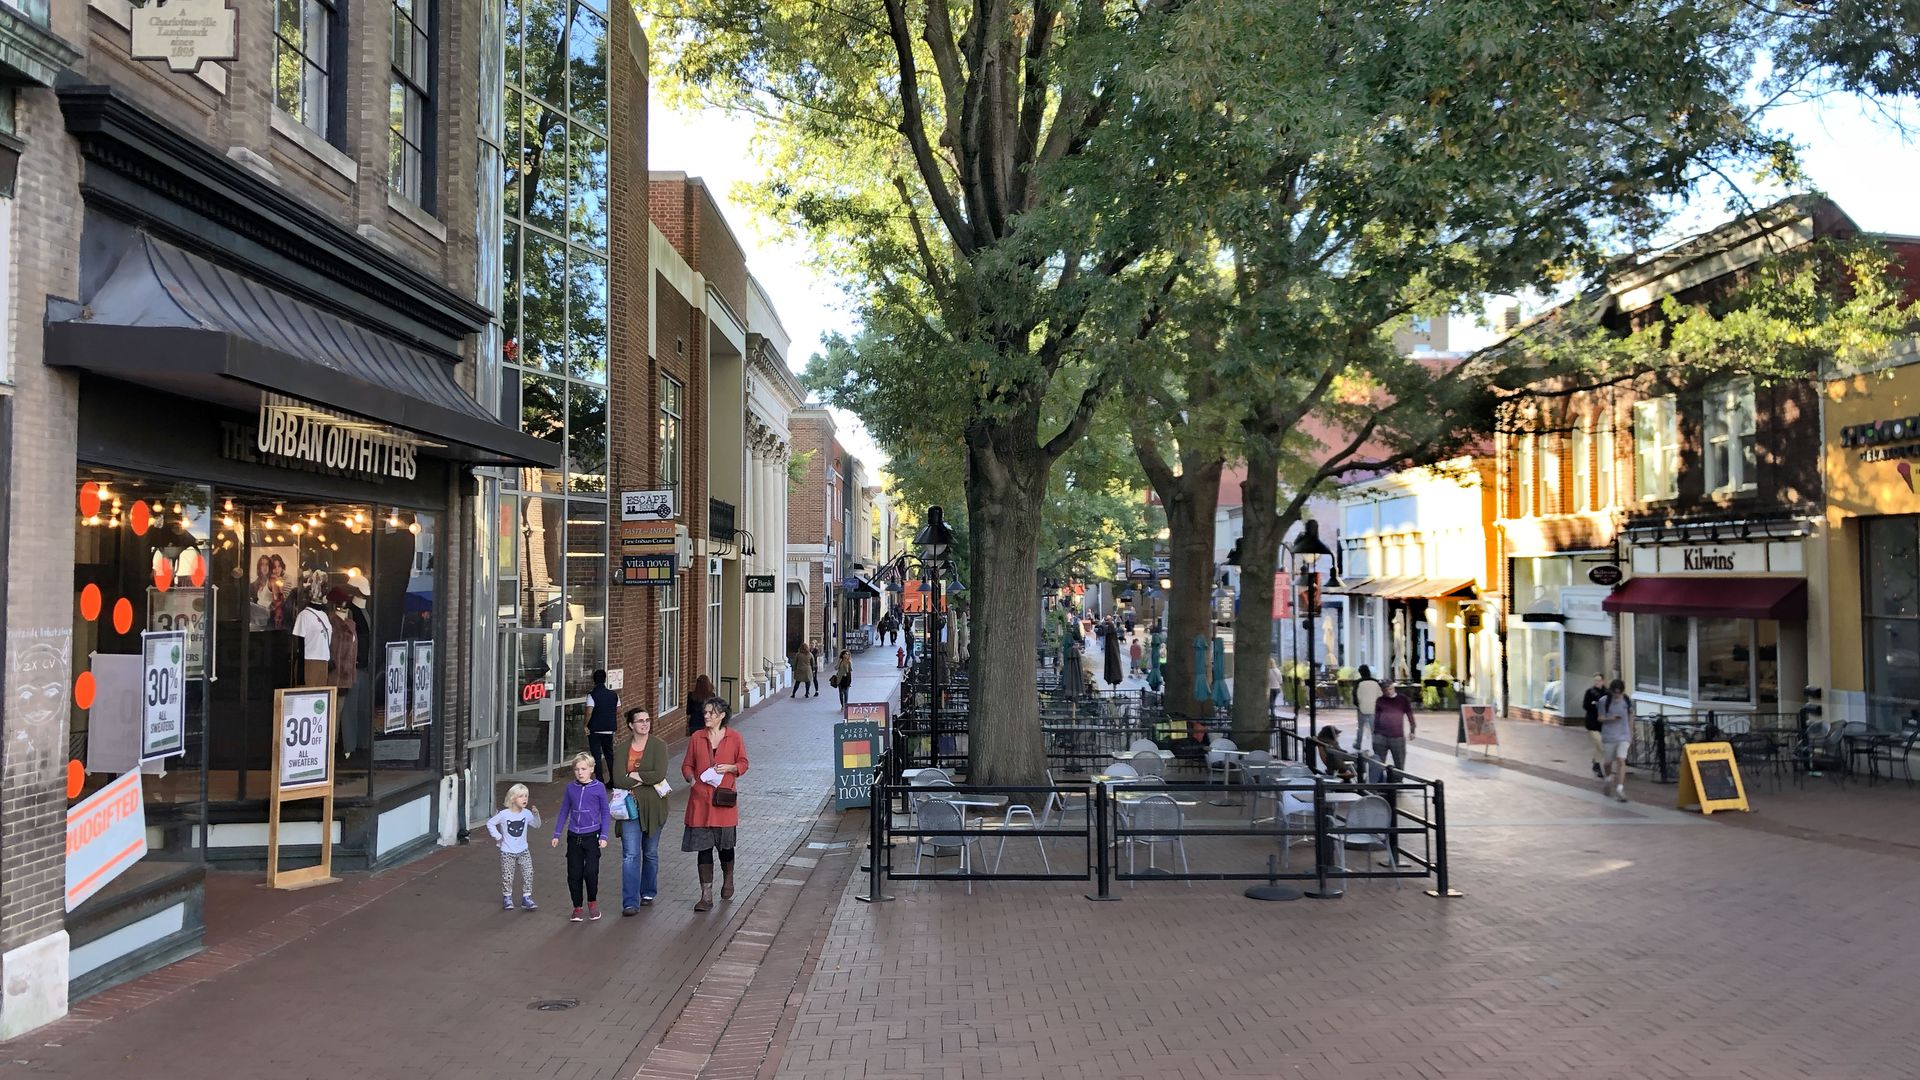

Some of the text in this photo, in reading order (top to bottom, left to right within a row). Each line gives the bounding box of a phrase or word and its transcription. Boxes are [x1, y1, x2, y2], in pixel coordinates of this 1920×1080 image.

[157, 27, 208, 37] Landmark
[257, 405, 325, 463] URBAN
[325, 422, 417, 481] OUTFITTERS
[626, 495, 668, 505] ESCAPE
[626, 557, 670, 567] vita nova
[1683, 548, 1734, 571] Kilwins
[758, 579, 772, 587] Bank
[148, 666, 179, 707] 30%
[523, 682, 546, 700] OPEN
[168, 693, 179, 705] OFF
[158, 710, 167, 721] ALL
[852, 706, 880, 714] TASTE
[150, 720, 175, 734] SWEATERS
[286, 716, 323, 747] 30%
[311, 736, 322, 745] OFF
[298, 750, 309, 758] ALL
[288, 758, 319, 768] SWEATERS
[840, 769, 875, 787] vita
